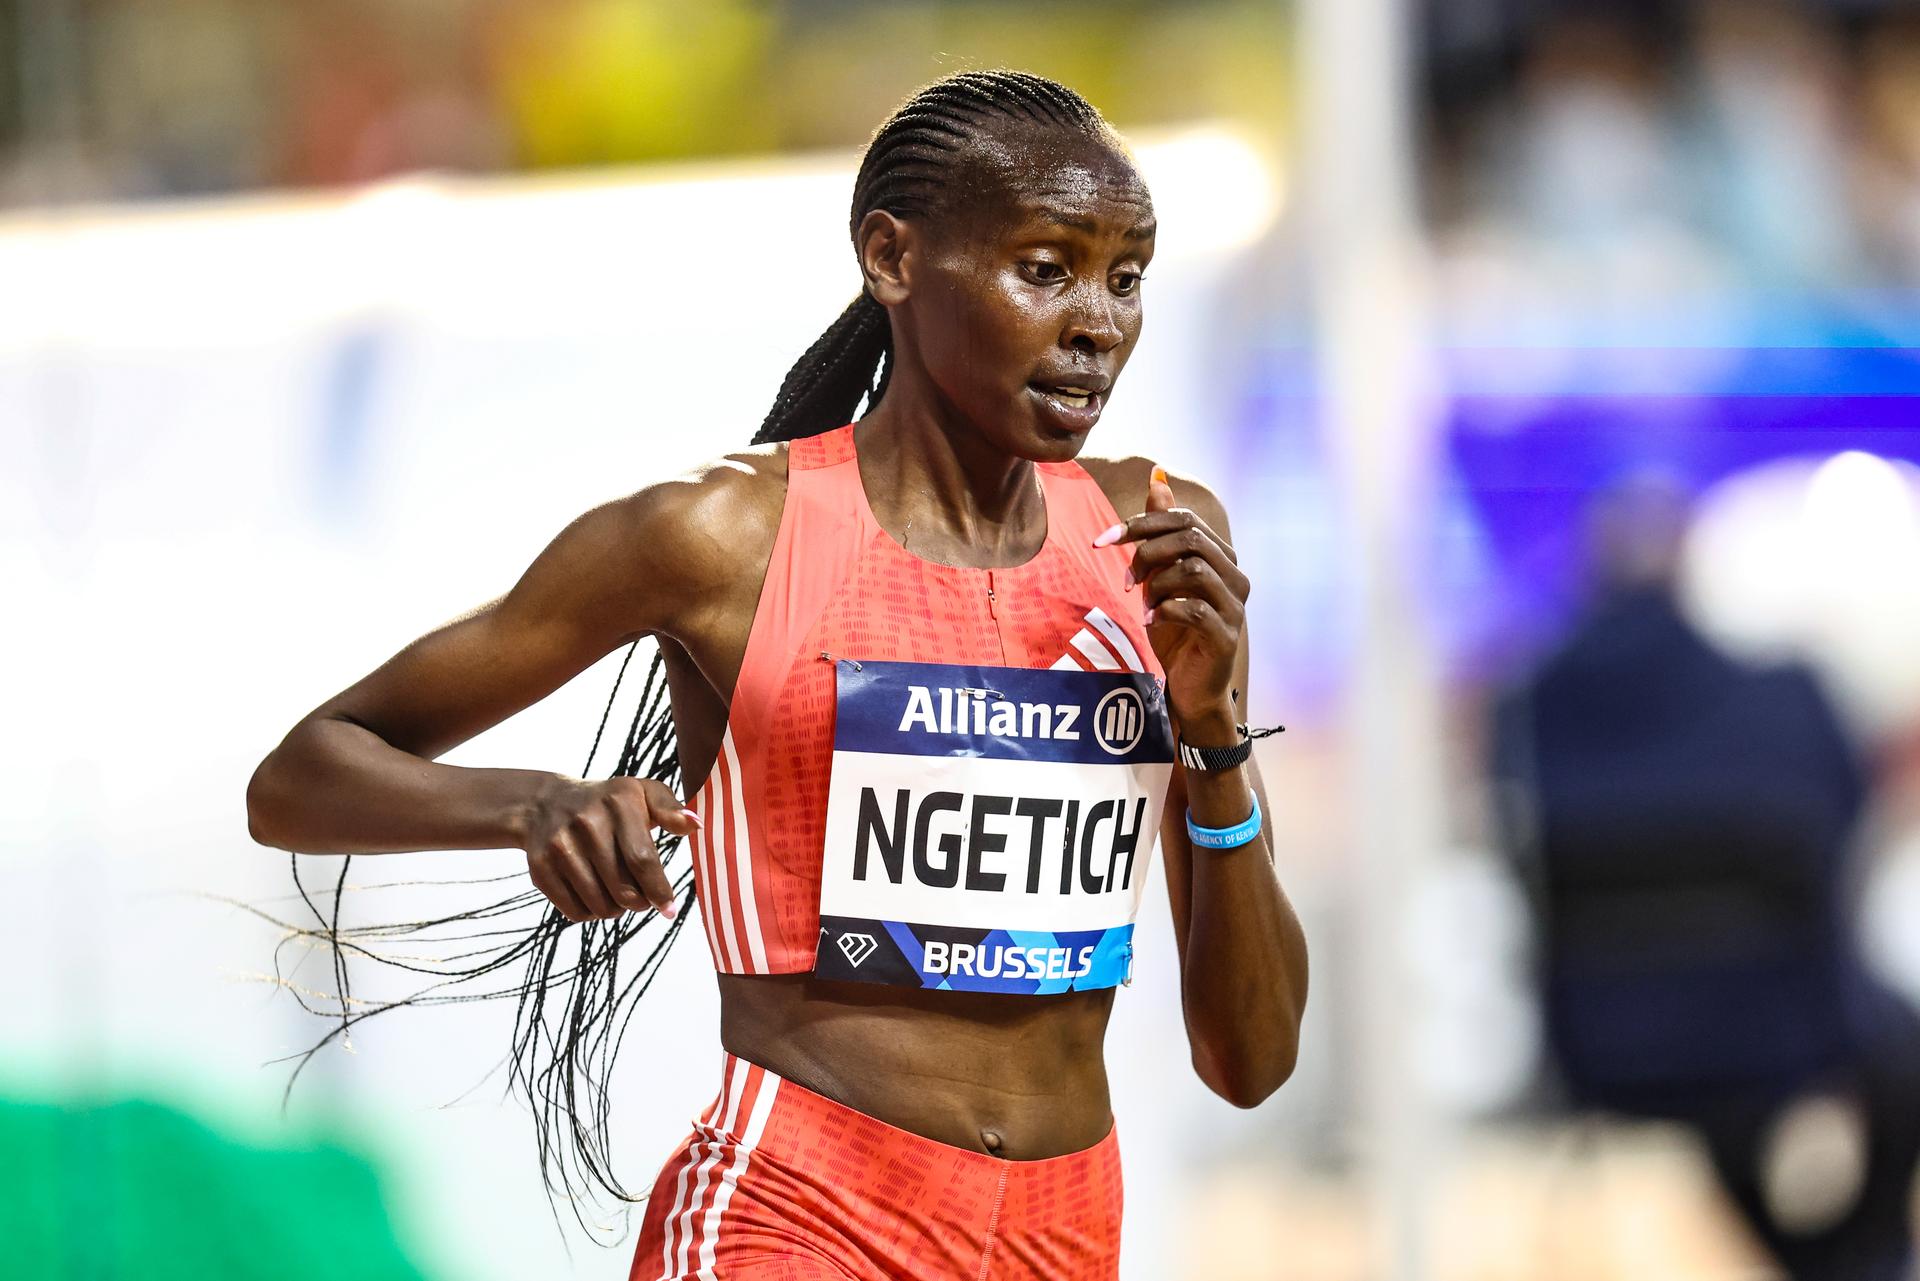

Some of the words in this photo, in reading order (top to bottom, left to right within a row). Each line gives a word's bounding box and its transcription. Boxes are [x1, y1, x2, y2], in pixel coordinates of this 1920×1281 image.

[898, 686, 1081, 740] Allianz
[852, 787, 1147, 895] NGETICH
[1199, 832, 1222, 845] AGENCY
[1225, 833, 1235, 844] OF
[922, 940, 1095, 979] BRUSSELS
